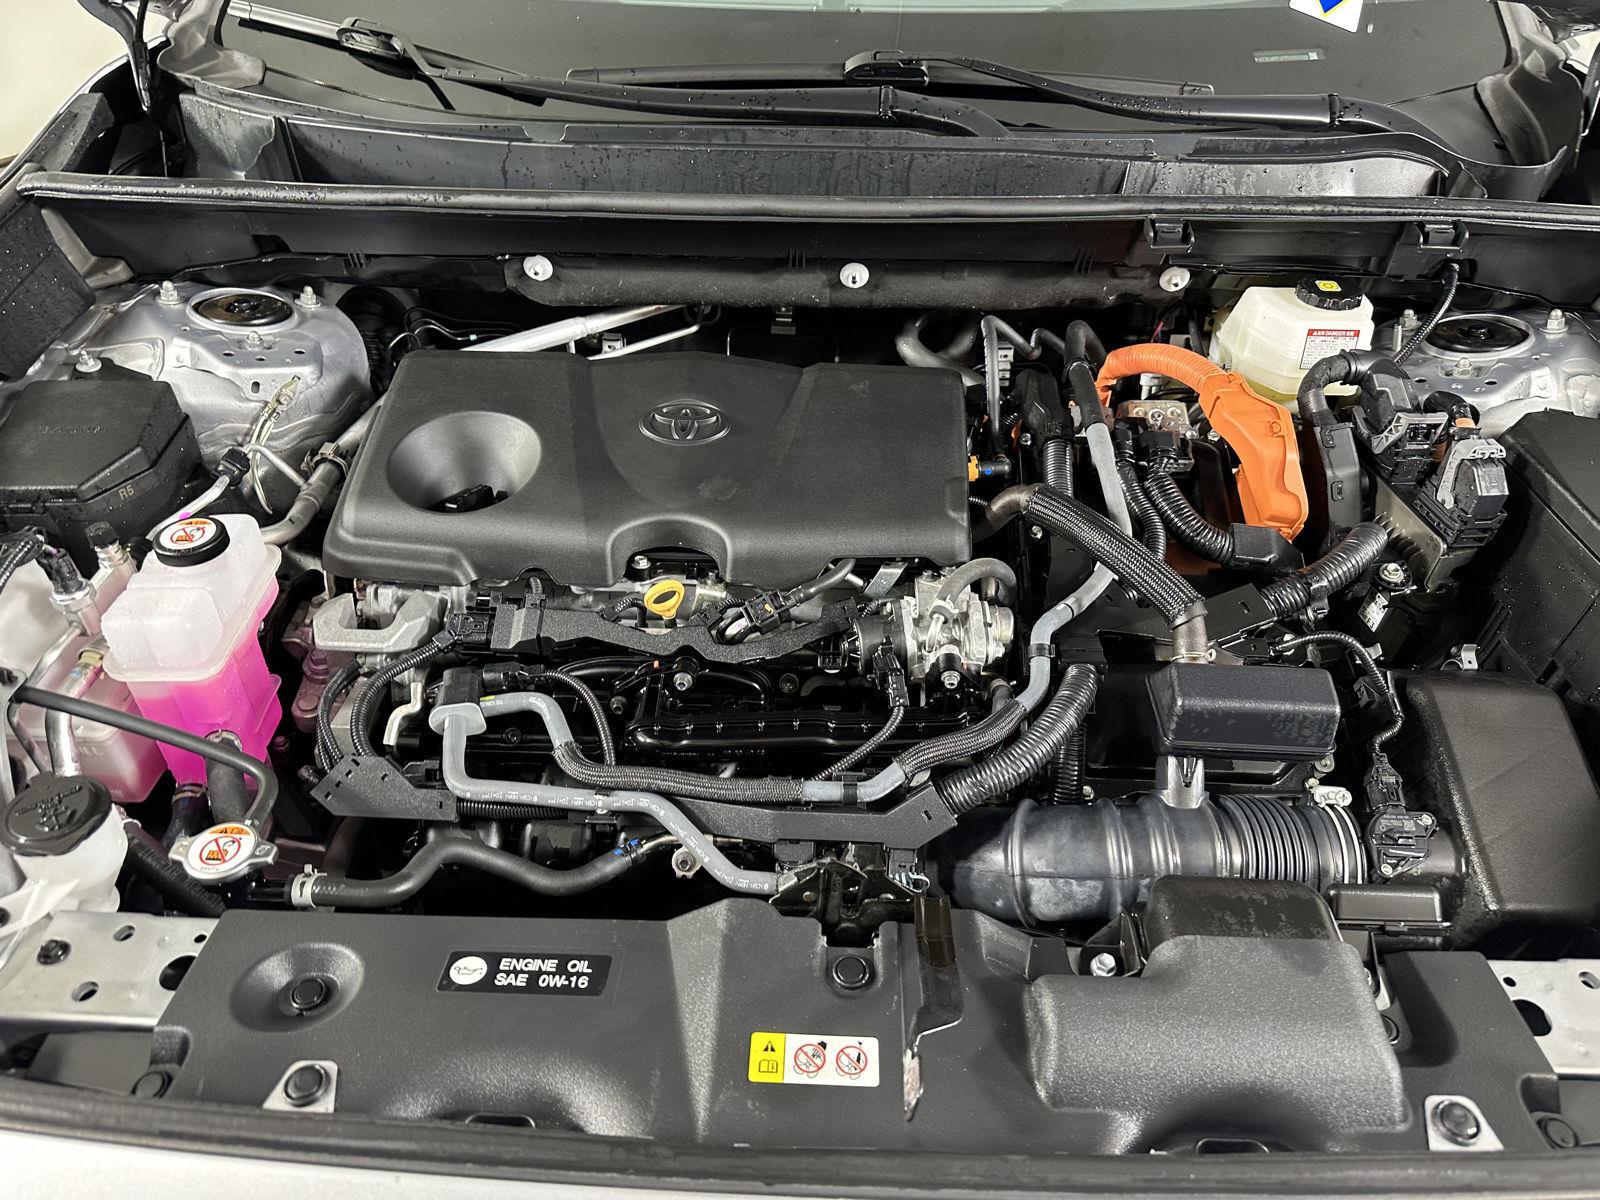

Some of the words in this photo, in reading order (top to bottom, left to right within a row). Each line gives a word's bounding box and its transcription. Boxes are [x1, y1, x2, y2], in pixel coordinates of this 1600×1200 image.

[499, 958, 558, 971] ENGINE
[567, 960, 592, 973] OIL
[495, 973, 528, 986] SAE
[539, 975, 589, 988] 0W-16
